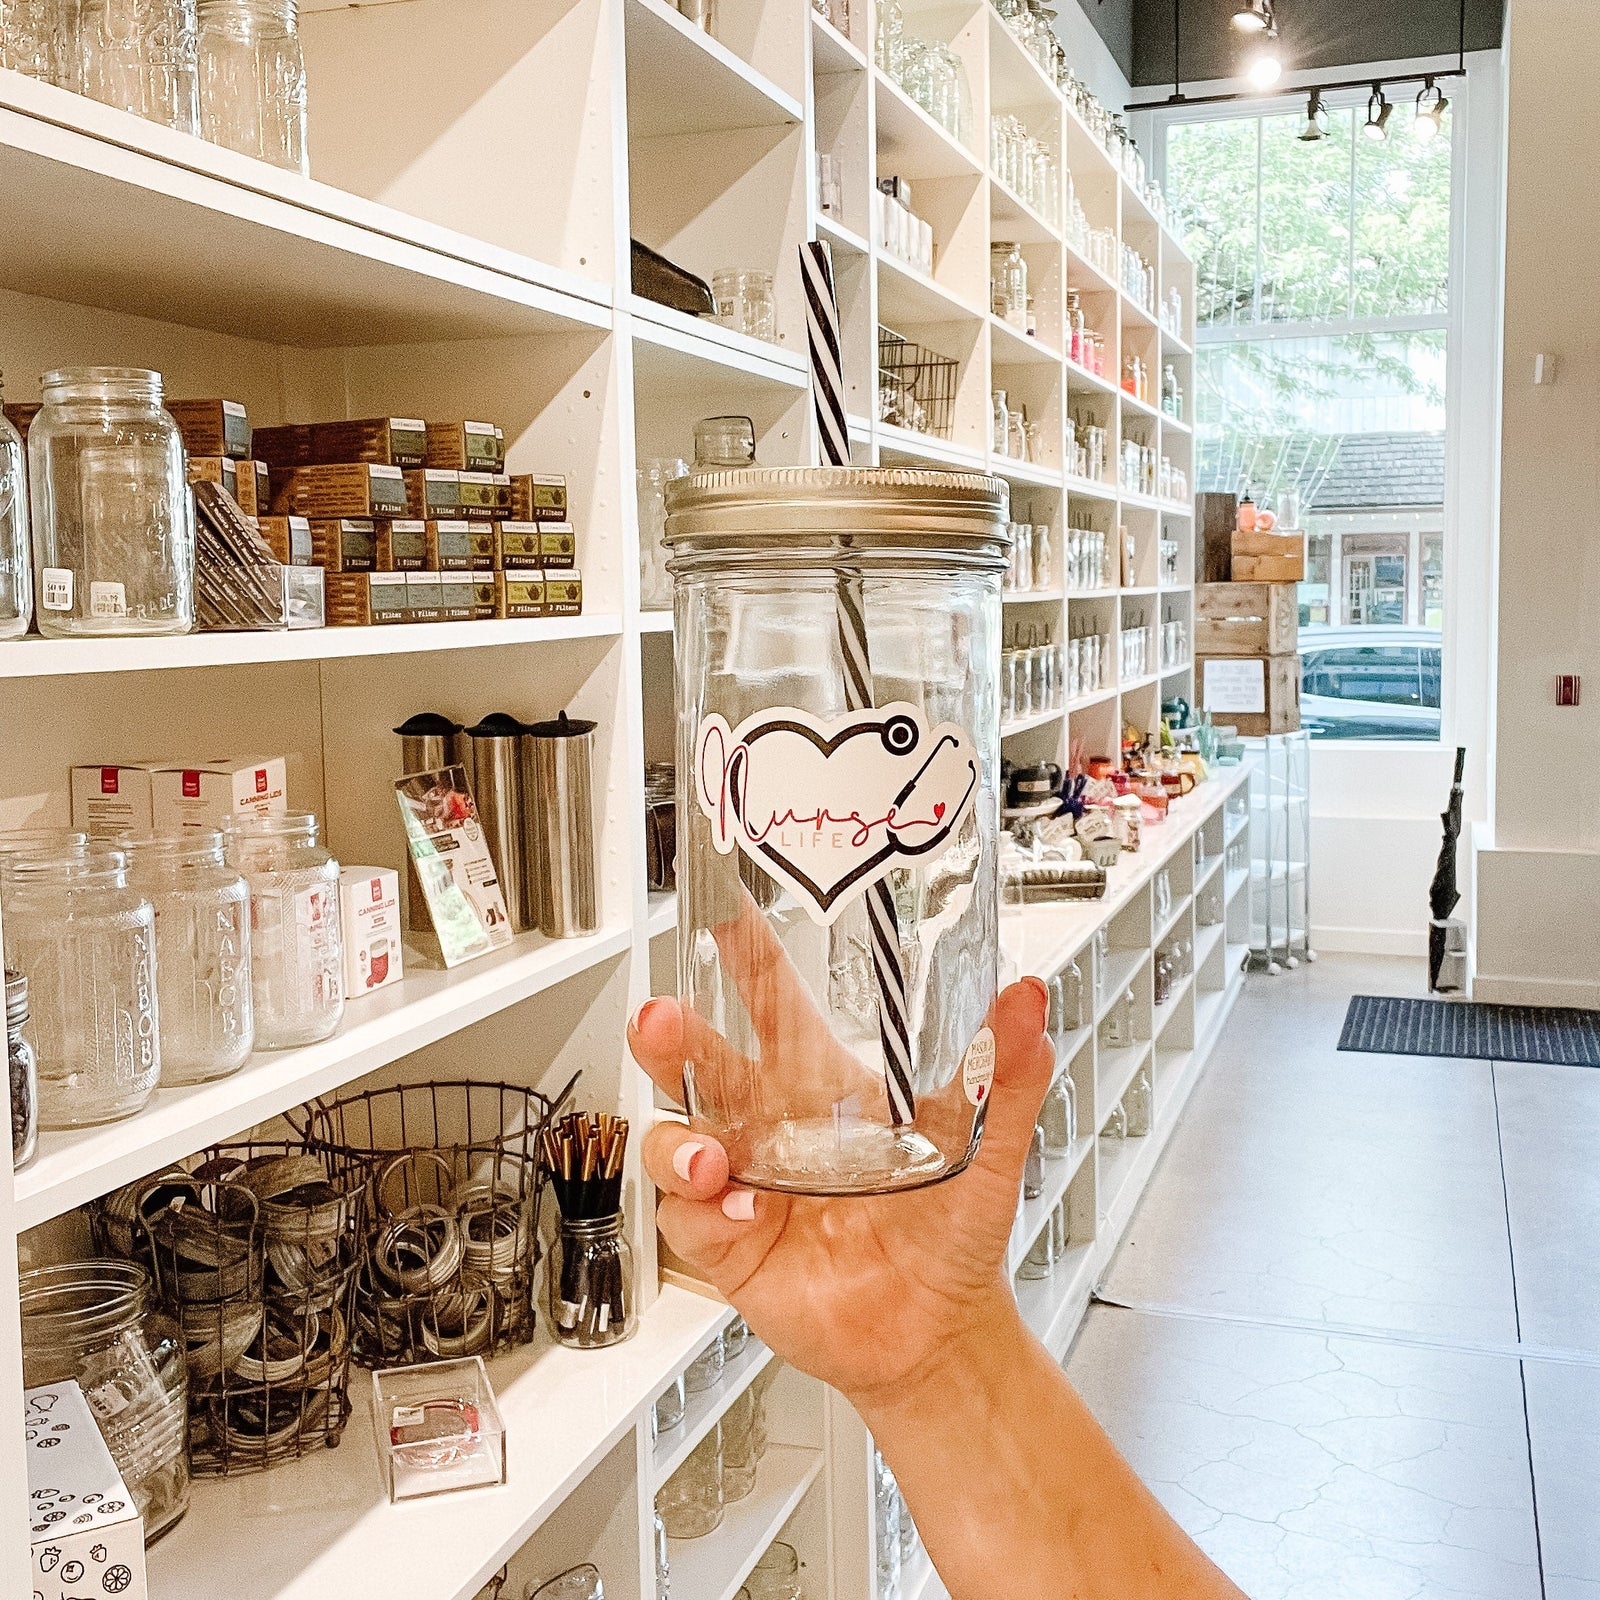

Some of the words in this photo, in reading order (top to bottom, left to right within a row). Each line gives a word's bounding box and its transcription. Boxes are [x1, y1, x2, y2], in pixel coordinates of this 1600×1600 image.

[701, 726, 942, 848] Nurse
[240, 793, 268, 807] CANNING
[780, 830, 844, 849] LIFE
